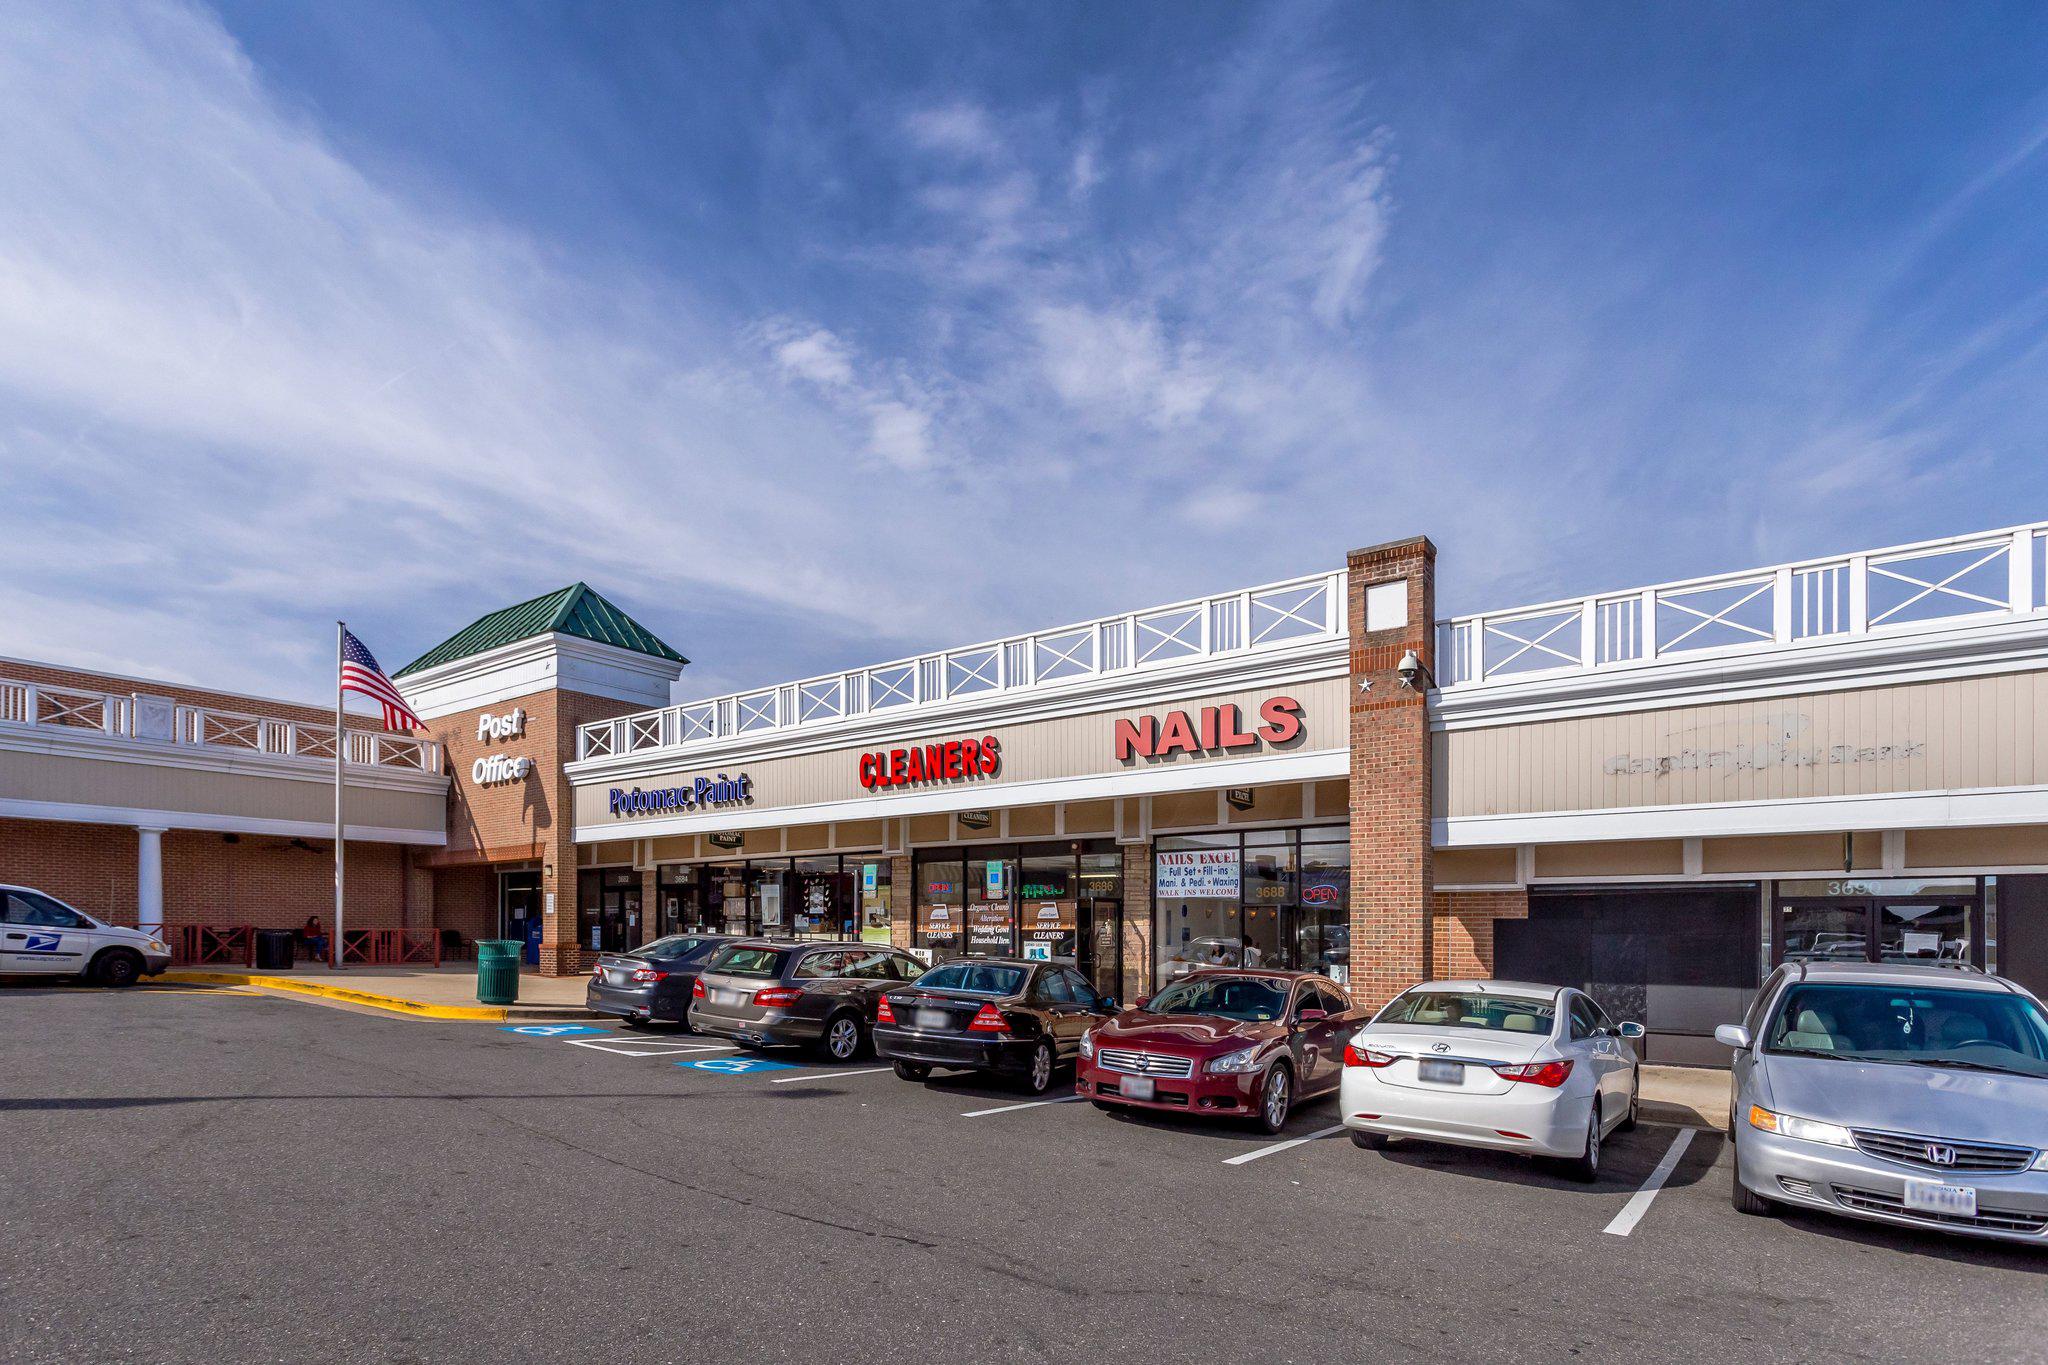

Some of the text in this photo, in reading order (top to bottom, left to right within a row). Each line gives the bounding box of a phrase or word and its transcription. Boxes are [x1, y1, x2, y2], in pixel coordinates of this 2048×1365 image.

[477, 707, 523, 741] Post
[1115, 696, 1301, 760] NAILS
[859, 735, 997, 789] CLEANERS
[472, 754, 530, 784] Office
[609, 773, 747, 814] Potomac Paint
[719, 835, 737, 843] PAINT
[1159, 852, 1239, 866] NAILS EXCEL
[1169, 865, 1228, 877] Full Set Fill-ins
[1089, 881, 1114, 891] 3686
[1158, 877, 1239, 889] Mani. & Pedi. Waxing
[1828, 880, 1882, 896] 3690
[1159, 889, 1179, 897] WALK
[1199, 888, 1239, 896] WELCOME
[1256, 886, 1285, 898] 3688
[1302, 888, 1338, 901] OPEN
[928, 922, 951, 930] SERVICE
[972, 925, 995, 935] Wedding
[1036, 921, 1062, 929] SERVICE
[926, 931, 954, 939] CLEANERS
[970, 936, 998, 944] Household
[1033, 931, 1065, 940] CLEANERS
